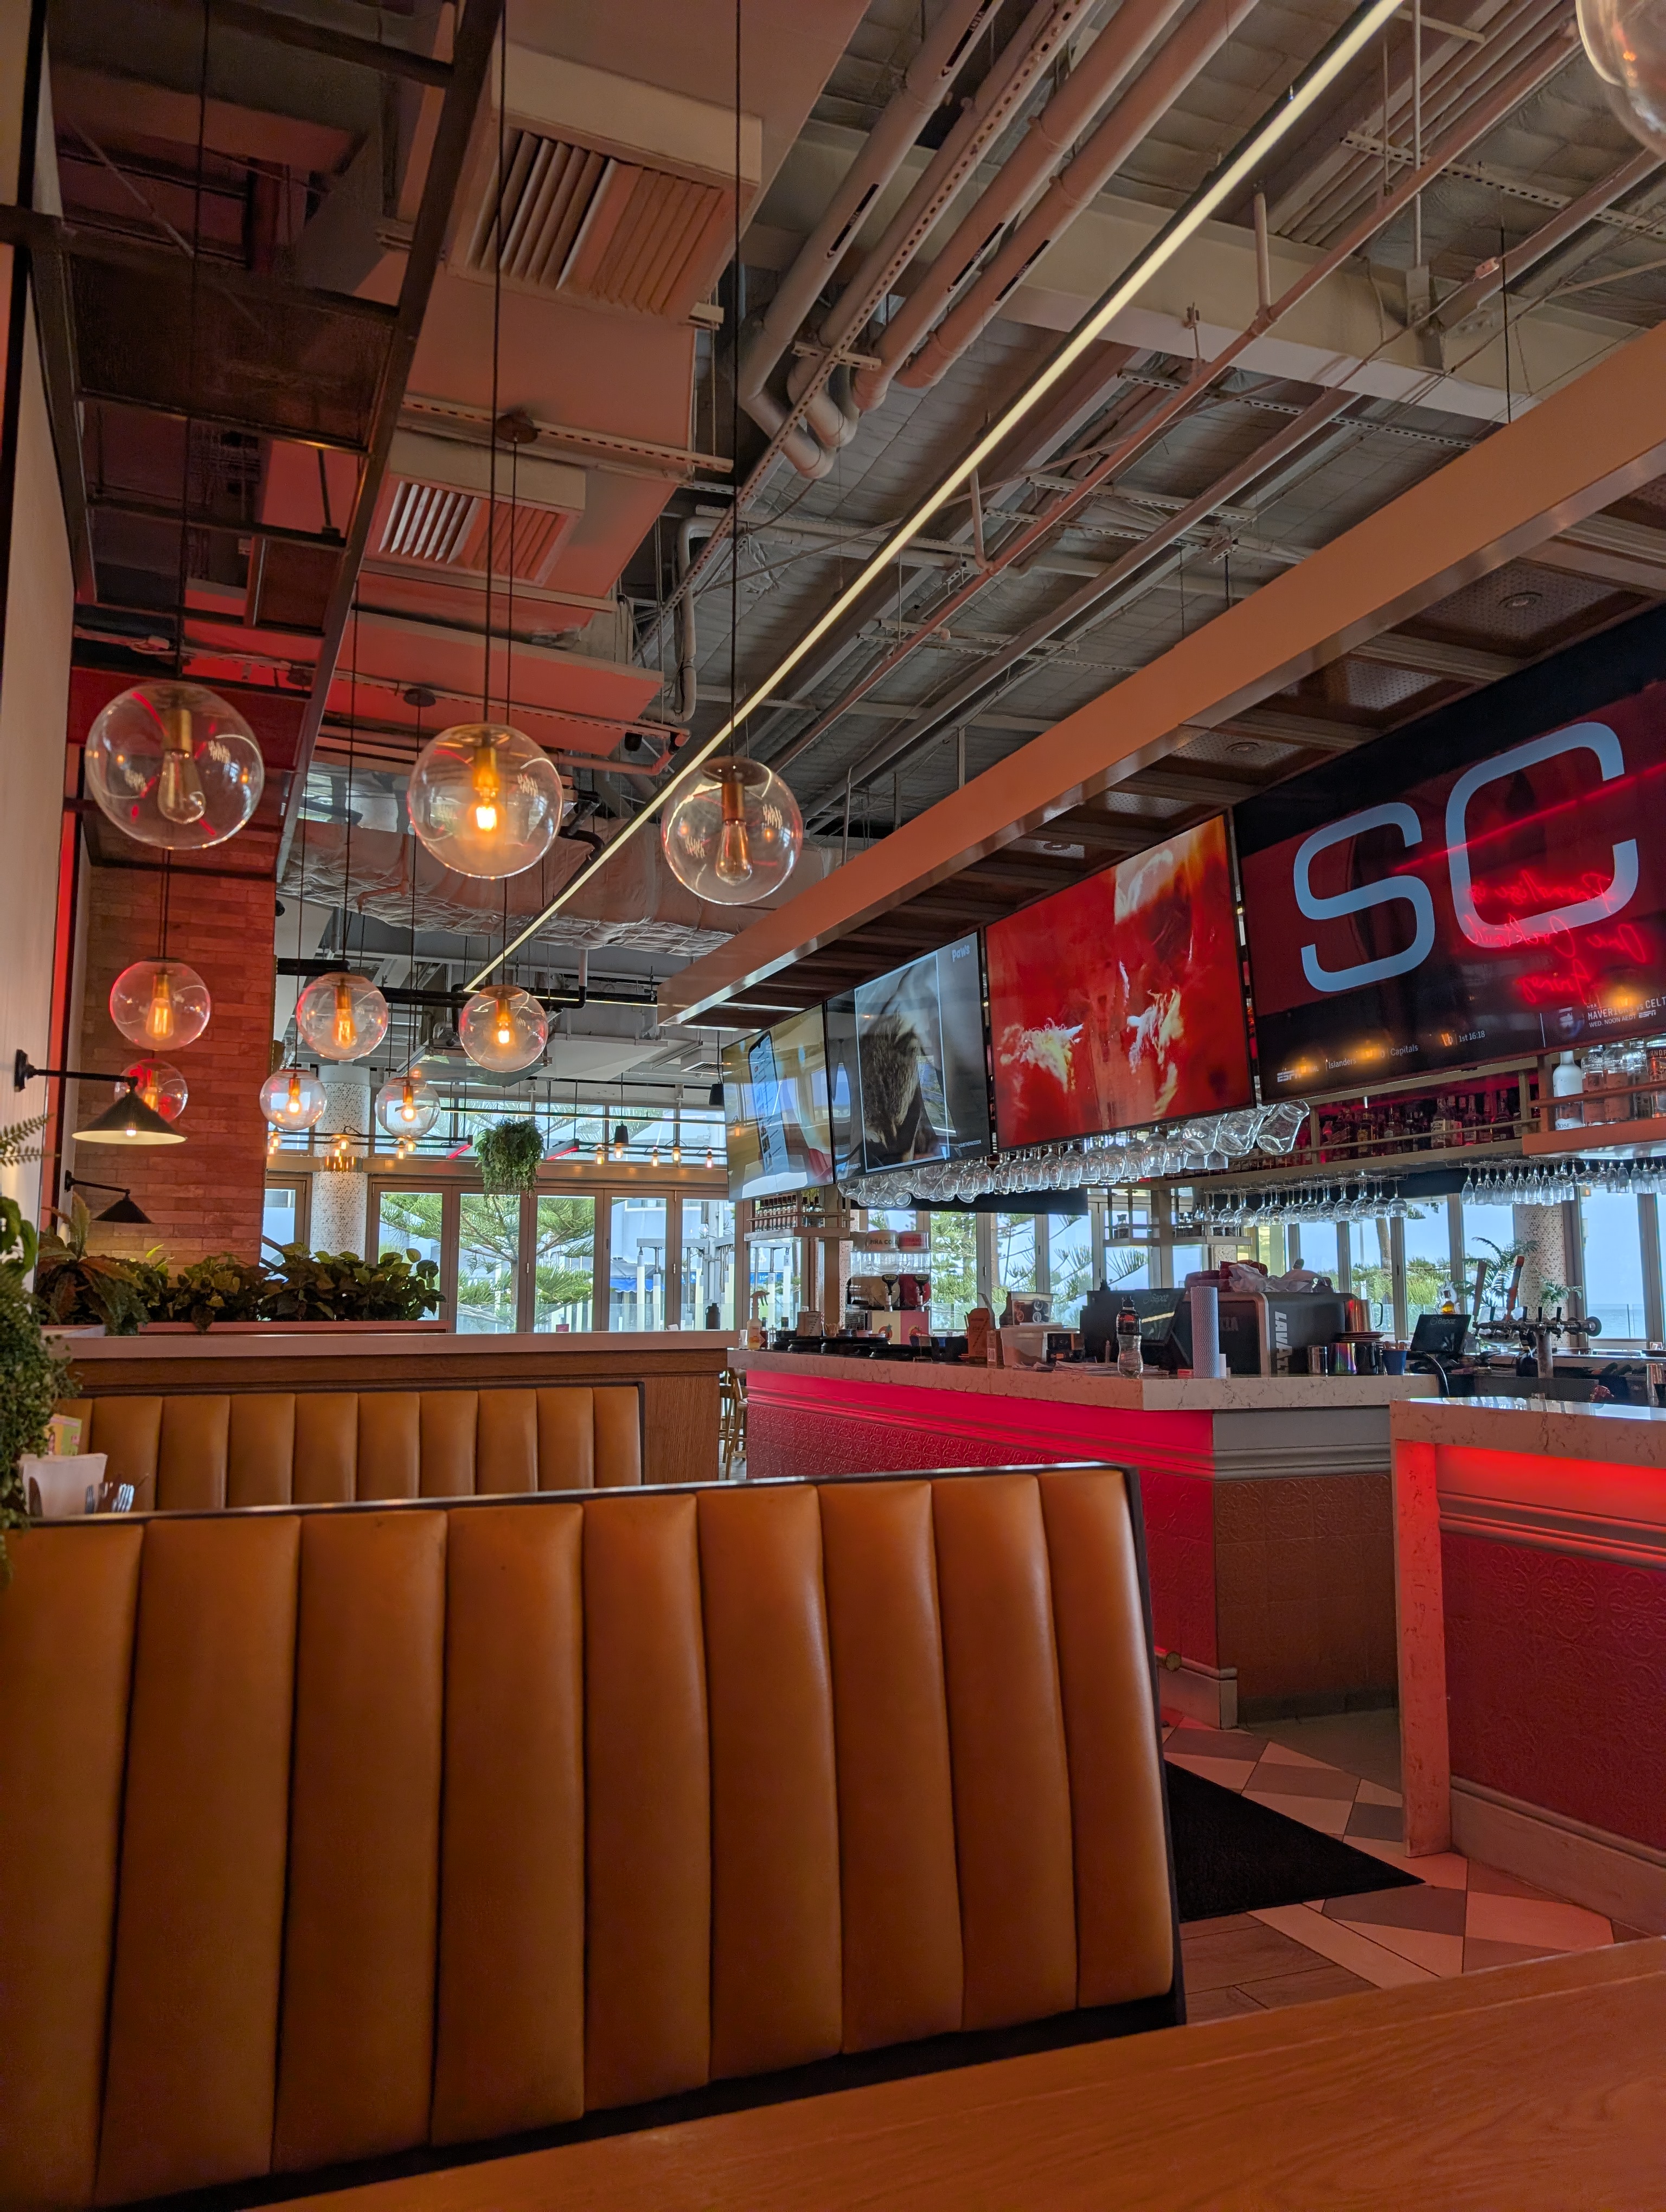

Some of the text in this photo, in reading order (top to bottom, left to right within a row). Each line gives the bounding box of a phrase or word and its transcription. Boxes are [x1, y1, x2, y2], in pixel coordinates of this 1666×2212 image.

[1604, 1017, 1620, 1025] NOON
[1622, 1013, 1636, 1021] AEDT
[1638, 1009, 1656, 1019] ESPN
[1329, 1058, 1357, 1069] Islanders
[1391, 1044, 1419, 1057] Capitals
[1469, 1030, 1485, 1040] 16:18
